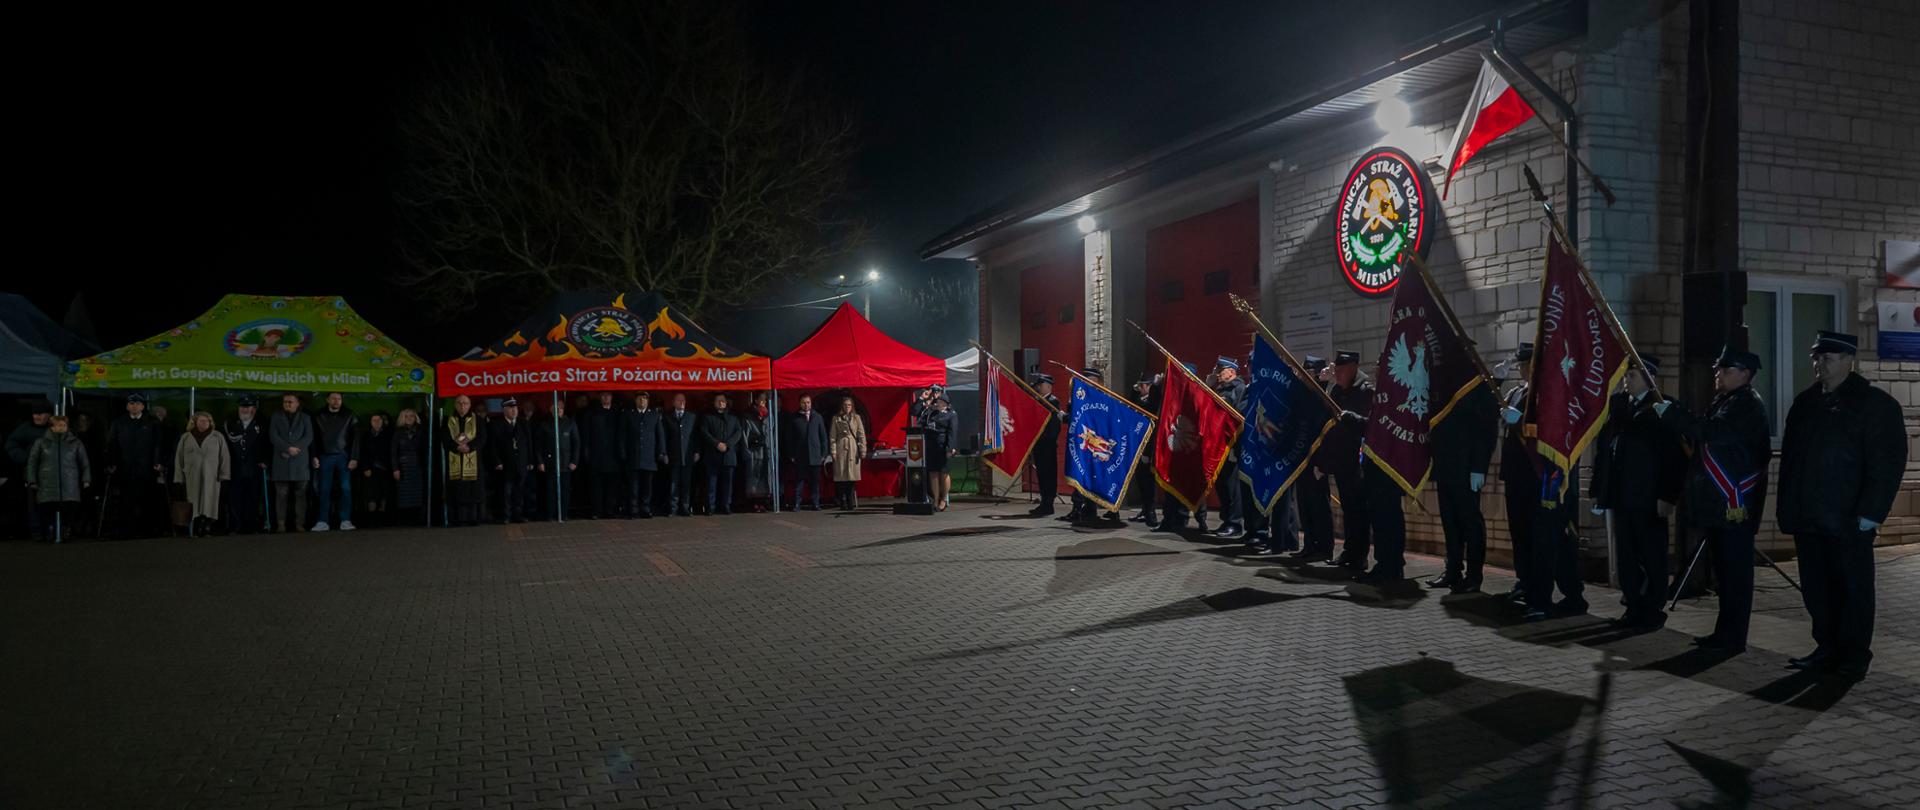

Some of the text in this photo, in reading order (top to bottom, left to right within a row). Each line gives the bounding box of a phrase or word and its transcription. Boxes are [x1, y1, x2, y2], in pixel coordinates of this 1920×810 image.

[1341, 160, 1419, 262] OCHOTNICZA STRAŻ POŻARN
[1356, 263, 1401, 286] MIENIA
[1581, 308, 1605, 397] LUDOWEJ
[170, 367, 241, 383] Gospodyń
[246, 369, 315, 384] Wiejskich
[318, 374, 331, 383] w
[332, 371, 370, 385] Mieni
[454, 366, 753, 388] Ochotnicza Straż Pożarna w Mieni
